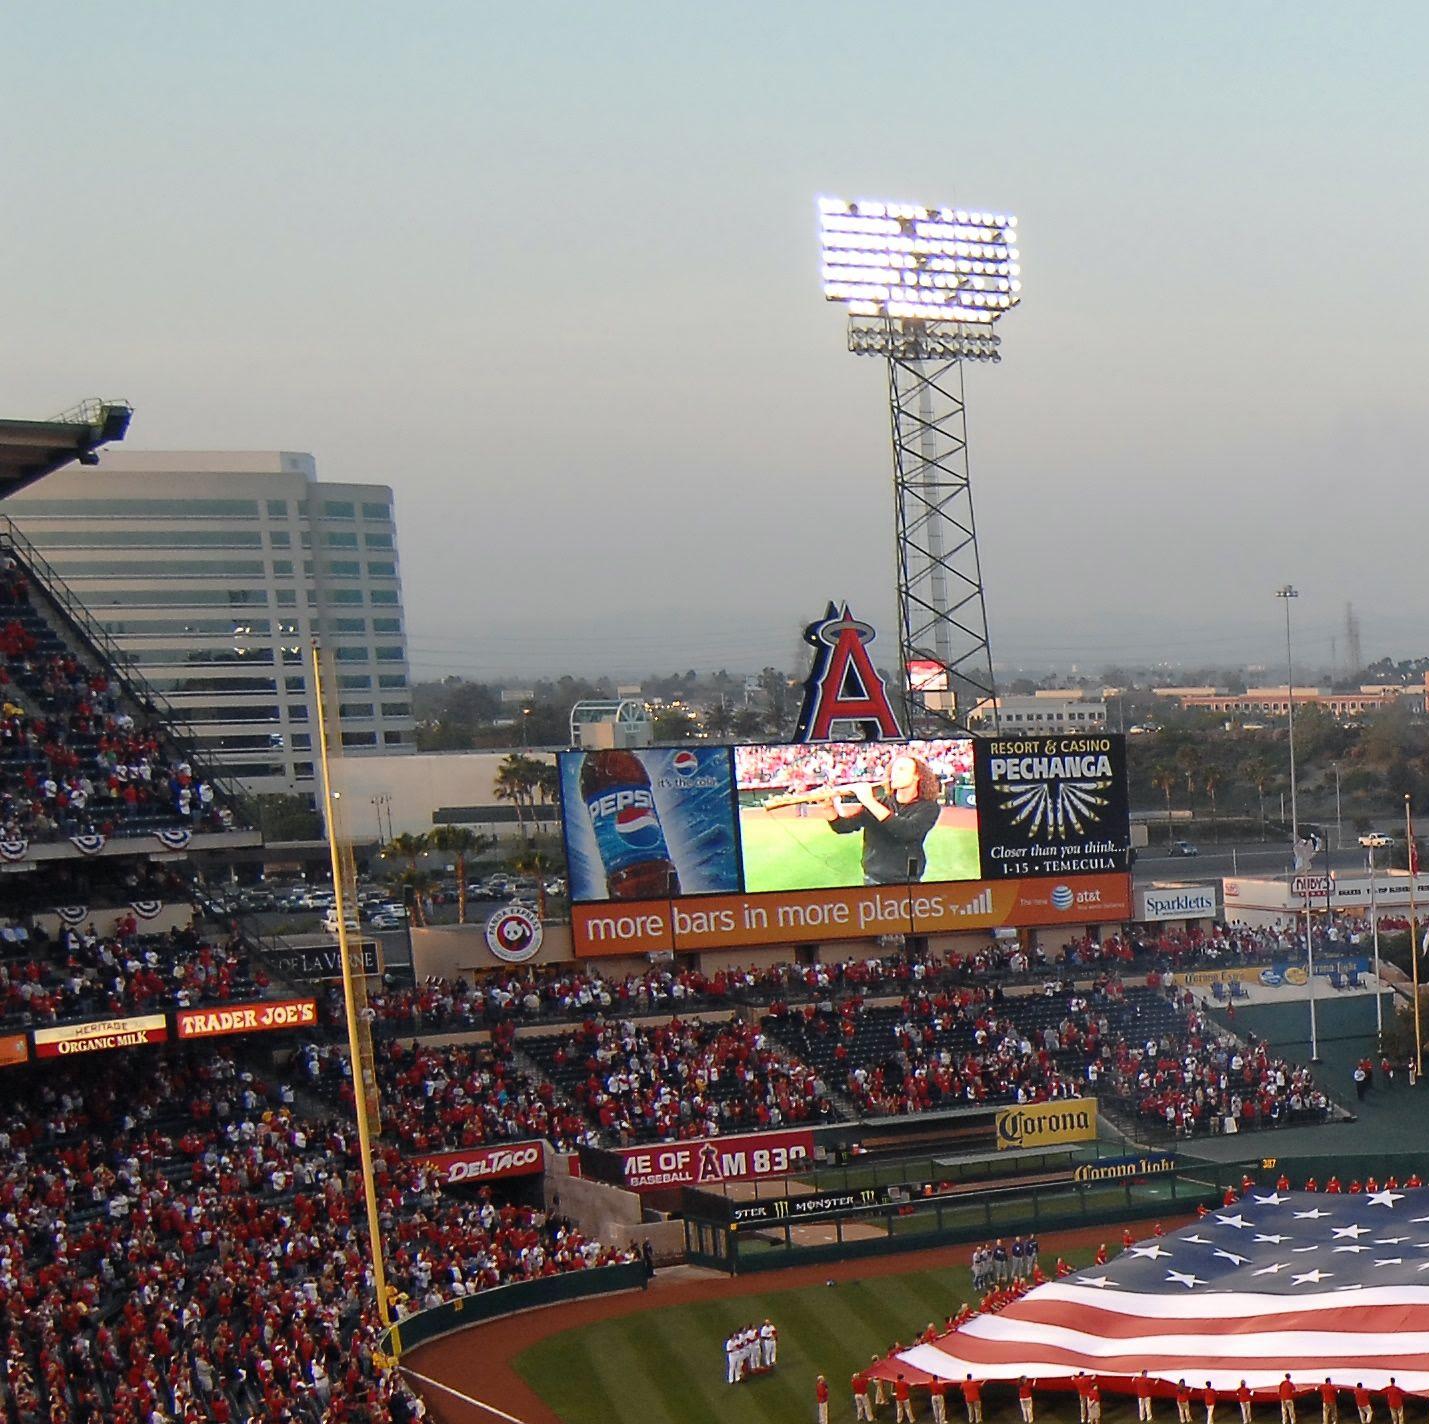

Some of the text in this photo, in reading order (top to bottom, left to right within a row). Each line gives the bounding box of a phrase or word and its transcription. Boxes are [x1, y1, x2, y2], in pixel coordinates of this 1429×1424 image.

[991, 740, 1110, 755] RESORT & CASINO
[991, 756, 1112, 780] PECHANGA
[991, 846, 1027, 859] Closer
[1031, 844, 1057, 857] than
[1060, 845, 1081, 858] you
[1004, 858, 1115, 874] I-15 TEMECULA
[1076, 890, 1101, 903] at&t
[1147, 896, 1212, 915] Sparkletts
[587, 894, 944, 941] more bars in more places
[182, 1003, 314, 1033] TRADER JOE'S
[75, 1022, 128, 1036] HERITAGE
[58, 1030, 149, 1054] ORGANIC MILK
[1000, 1107, 1090, 1145] Corona
[659, 1151, 690, 1171] OF
[630, 1172, 693, 1187] BASEBALL
[1074, 1163, 1136, 1181] Corona
[796, 1196, 854, 1212] MONSTER
